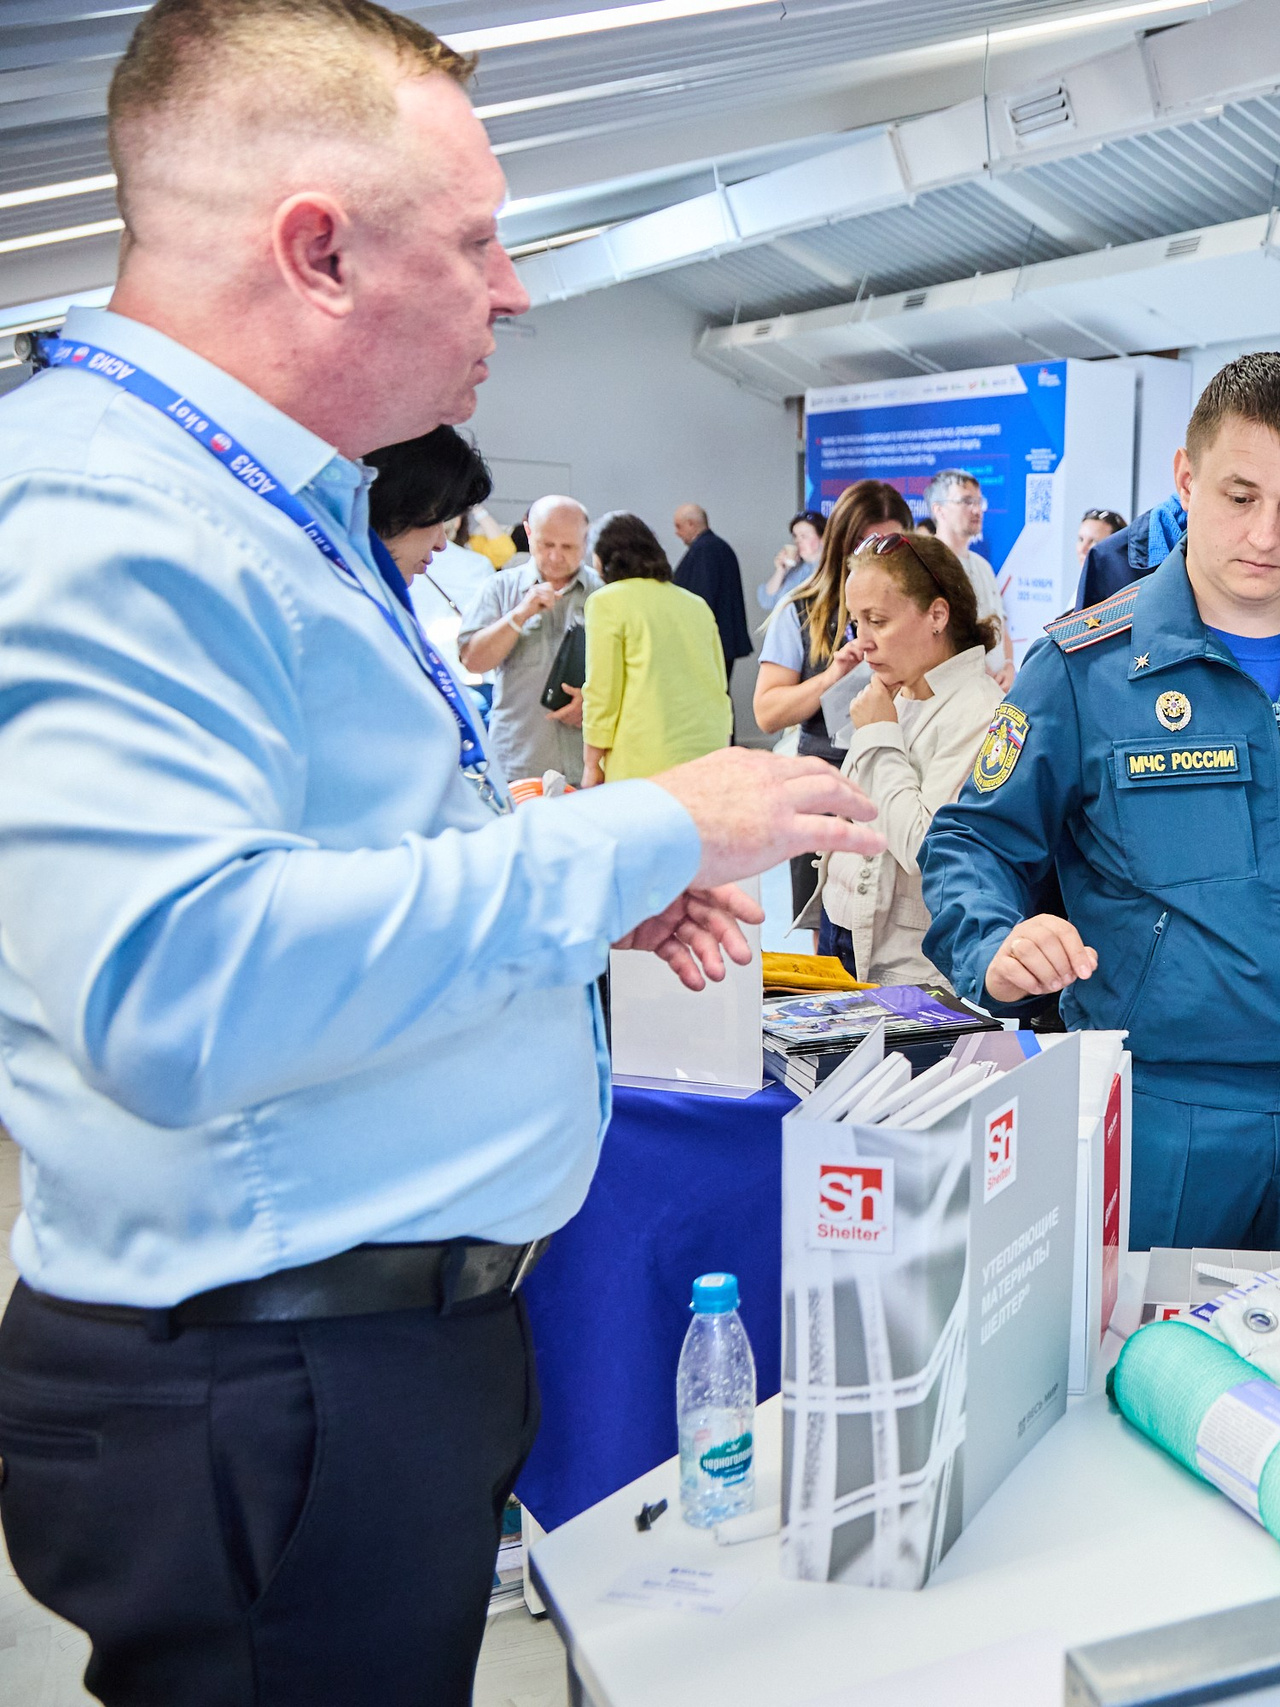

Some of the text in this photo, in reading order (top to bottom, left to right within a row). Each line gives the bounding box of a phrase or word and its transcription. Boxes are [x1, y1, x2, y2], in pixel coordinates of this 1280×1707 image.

[88, 351, 136, 381] АСИЗ
[230, 454, 278, 494] АСИЗ
[1129, 750, 1235, 774] МЧС РОССИИ
[818, 1171, 883, 1222] Sh
[982, 1206, 1060, 1286] УТЕПЛЯЮЩИЕ
[981, 1241, 1050, 1316] МАТЕРИАЛЫ
